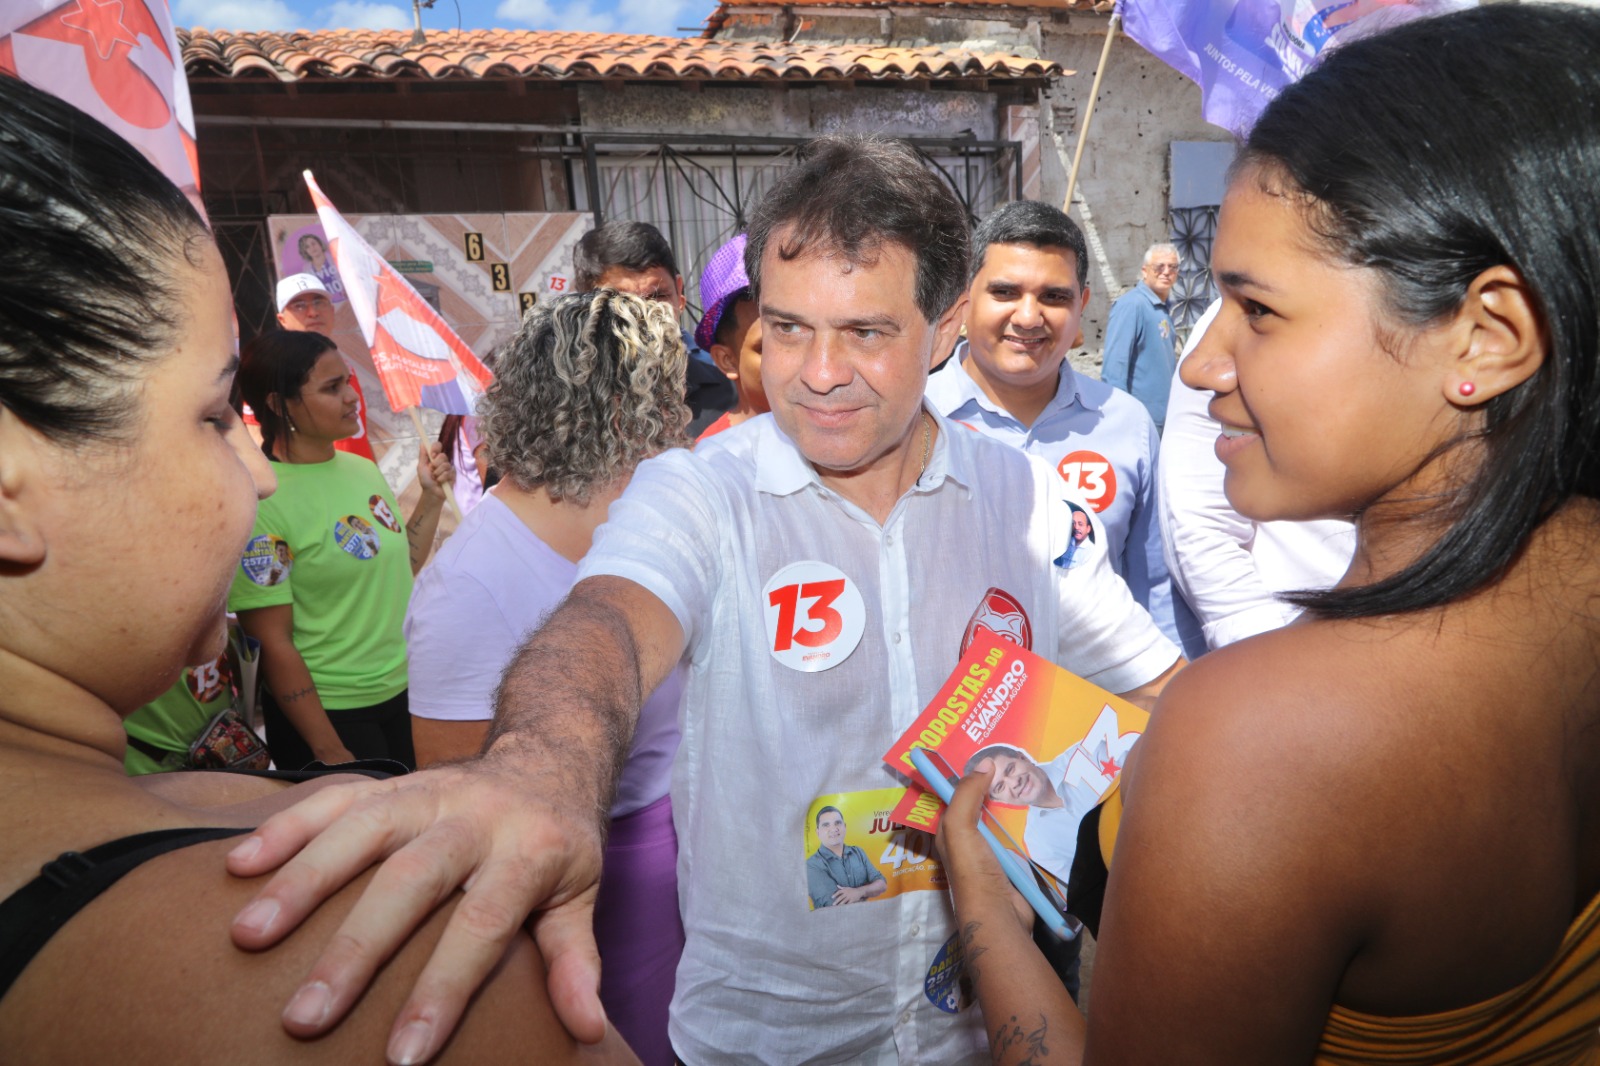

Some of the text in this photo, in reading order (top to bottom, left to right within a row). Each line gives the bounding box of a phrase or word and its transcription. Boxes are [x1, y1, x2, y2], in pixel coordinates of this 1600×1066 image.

[1203, 42, 1237, 73] JUNTOS
[1234, 67, 1261, 90] PELA
[468, 233, 481, 260] 6
[494, 264, 507, 290] 3
[549, 276, 566, 291] 13
[1062, 461, 1109, 500] 13
[373, 498, 396, 528] 13
[243, 555, 274, 567] 25777
[768, 578, 846, 652] 13
[984, 647, 1004, 667] DO
[193, 659, 220, 694] 13
[960, 687, 993, 731] PREFEITO
[965, 659, 1025, 743] EVANDRO
[983, 700, 1012, 739] GABRIELLA
[1009, 672, 1029, 703] AGUIAR
[869, 817, 906, 834] JUL
[905, 792, 942, 827] PROP
